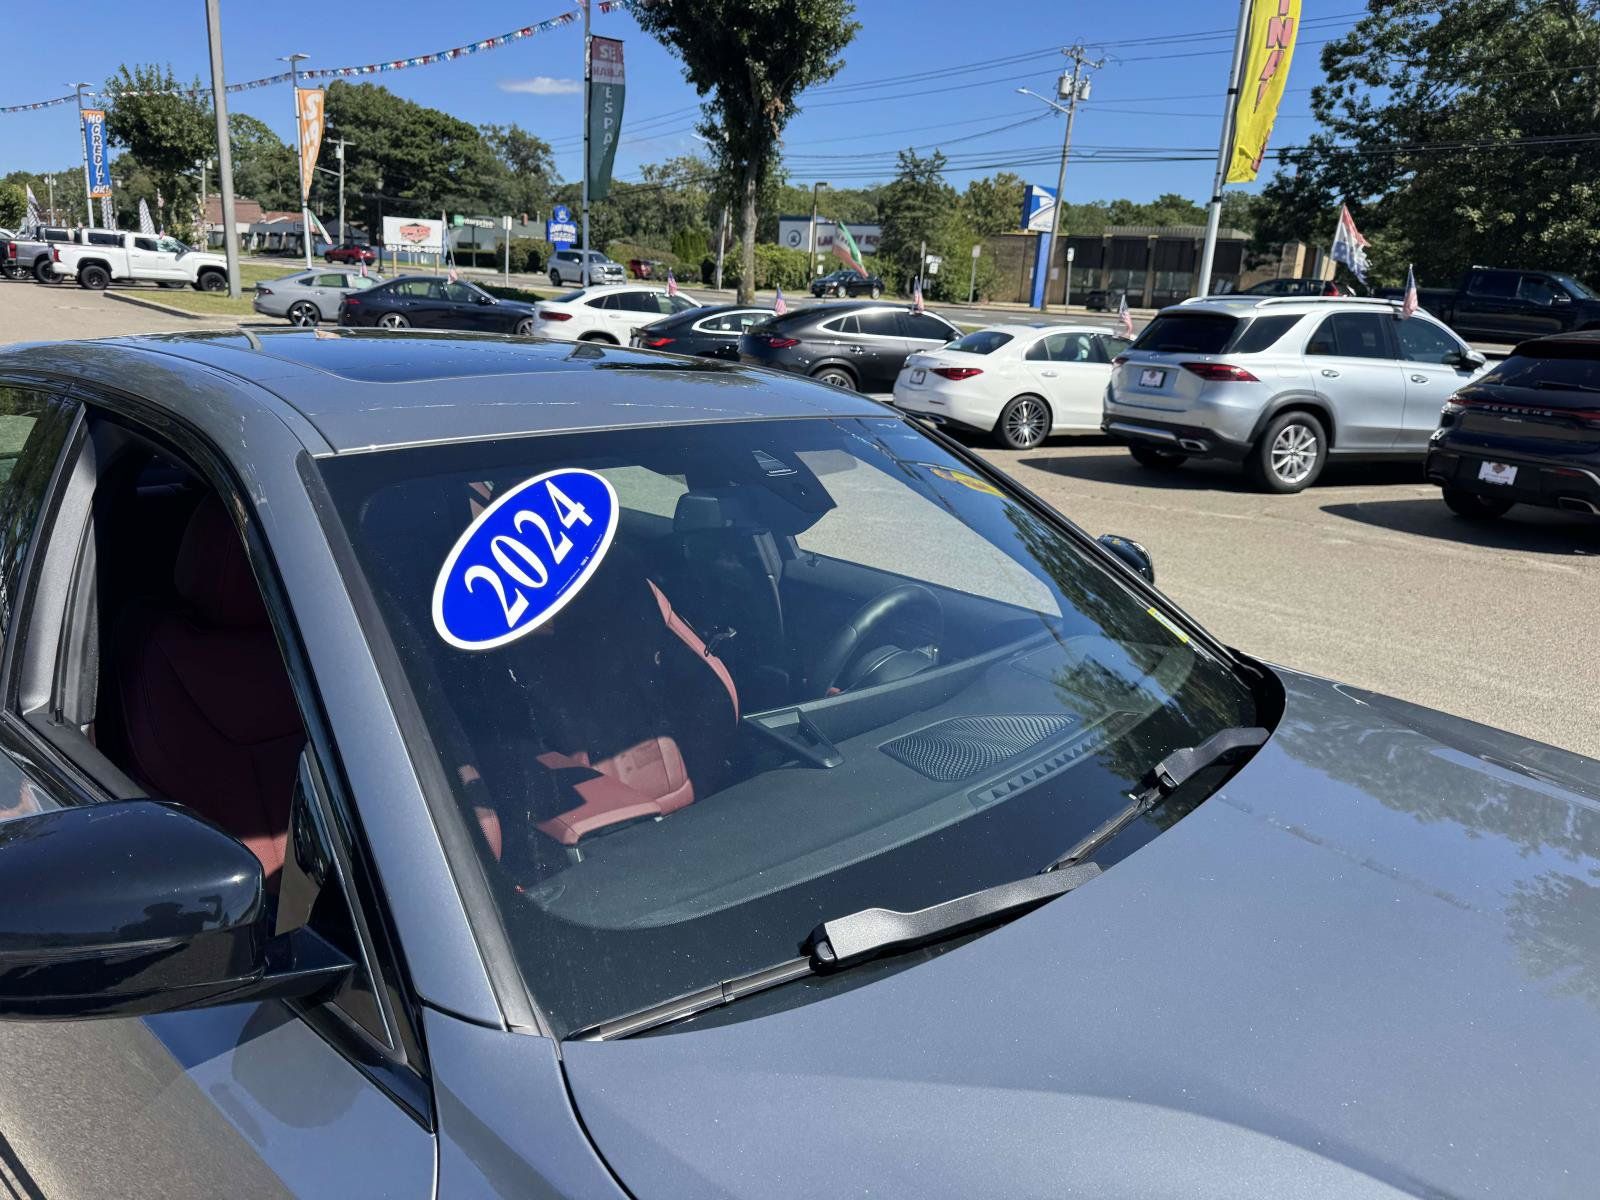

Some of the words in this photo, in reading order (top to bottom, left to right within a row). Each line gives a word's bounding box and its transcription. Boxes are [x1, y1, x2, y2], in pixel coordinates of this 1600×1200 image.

[599, 45, 616, 59] SE
[592, 66, 622, 78] HABLA
[88, 113, 102, 124] NO
[91, 124, 104, 185] CREDIT
[464, 479, 593, 628] 2024
